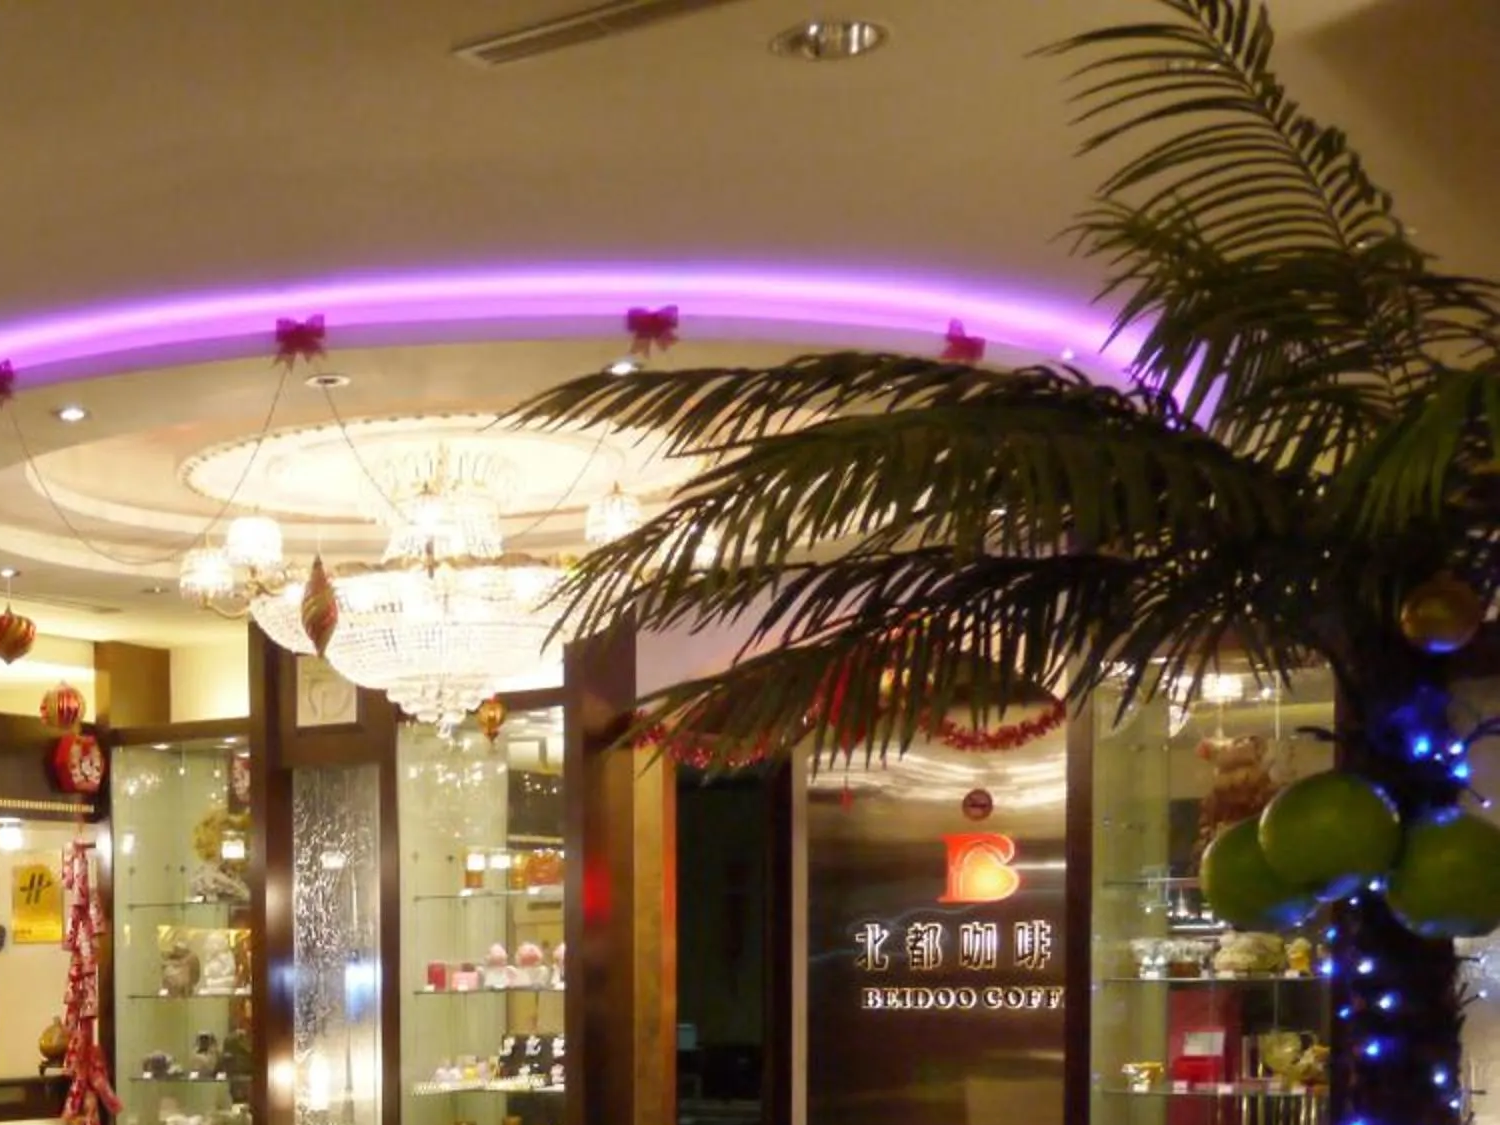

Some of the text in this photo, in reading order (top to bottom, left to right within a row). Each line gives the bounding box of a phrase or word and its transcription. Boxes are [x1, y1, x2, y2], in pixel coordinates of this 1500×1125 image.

[855, 919, 1053, 972] 北都咖啡
[861, 986, 1065, 1009] BEIDOO COFF
